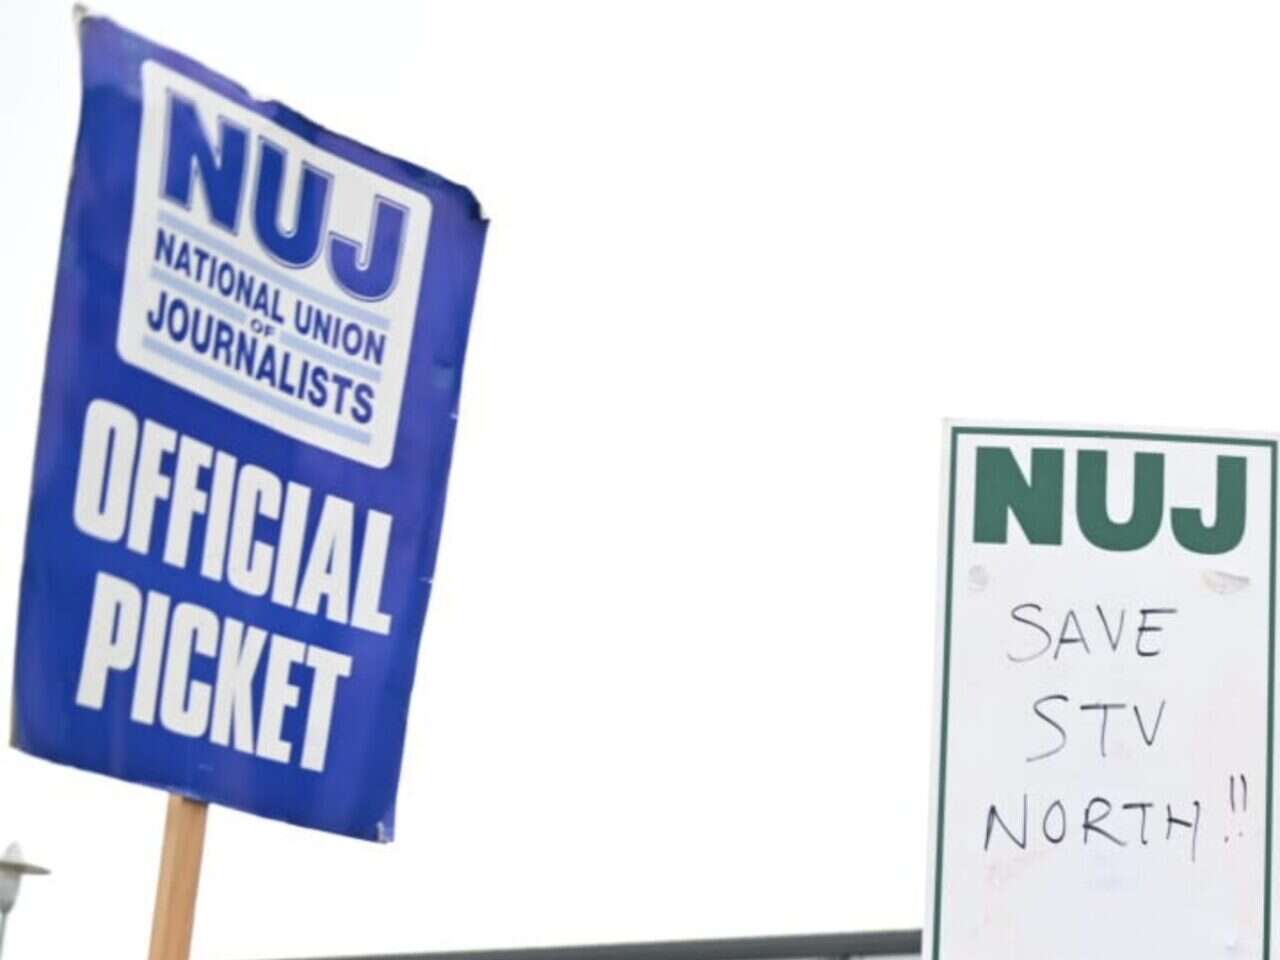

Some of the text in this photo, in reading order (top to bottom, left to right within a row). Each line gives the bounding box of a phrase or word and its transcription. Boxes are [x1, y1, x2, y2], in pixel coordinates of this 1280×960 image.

[158, 86, 411, 302] NUJ
[147, 292, 374, 424] JOURNALISTS
[154, 228, 386, 366] NATIONAL UNION
[249, 317, 276, 338] OF
[74, 398, 393, 635] OFFICIAL
[972, 446, 1247, 555] NUJ
[76, 571, 353, 772] PICKET
[1006, 603, 1178, 662] SAVE
[1026, 694, 1166, 762] STV
